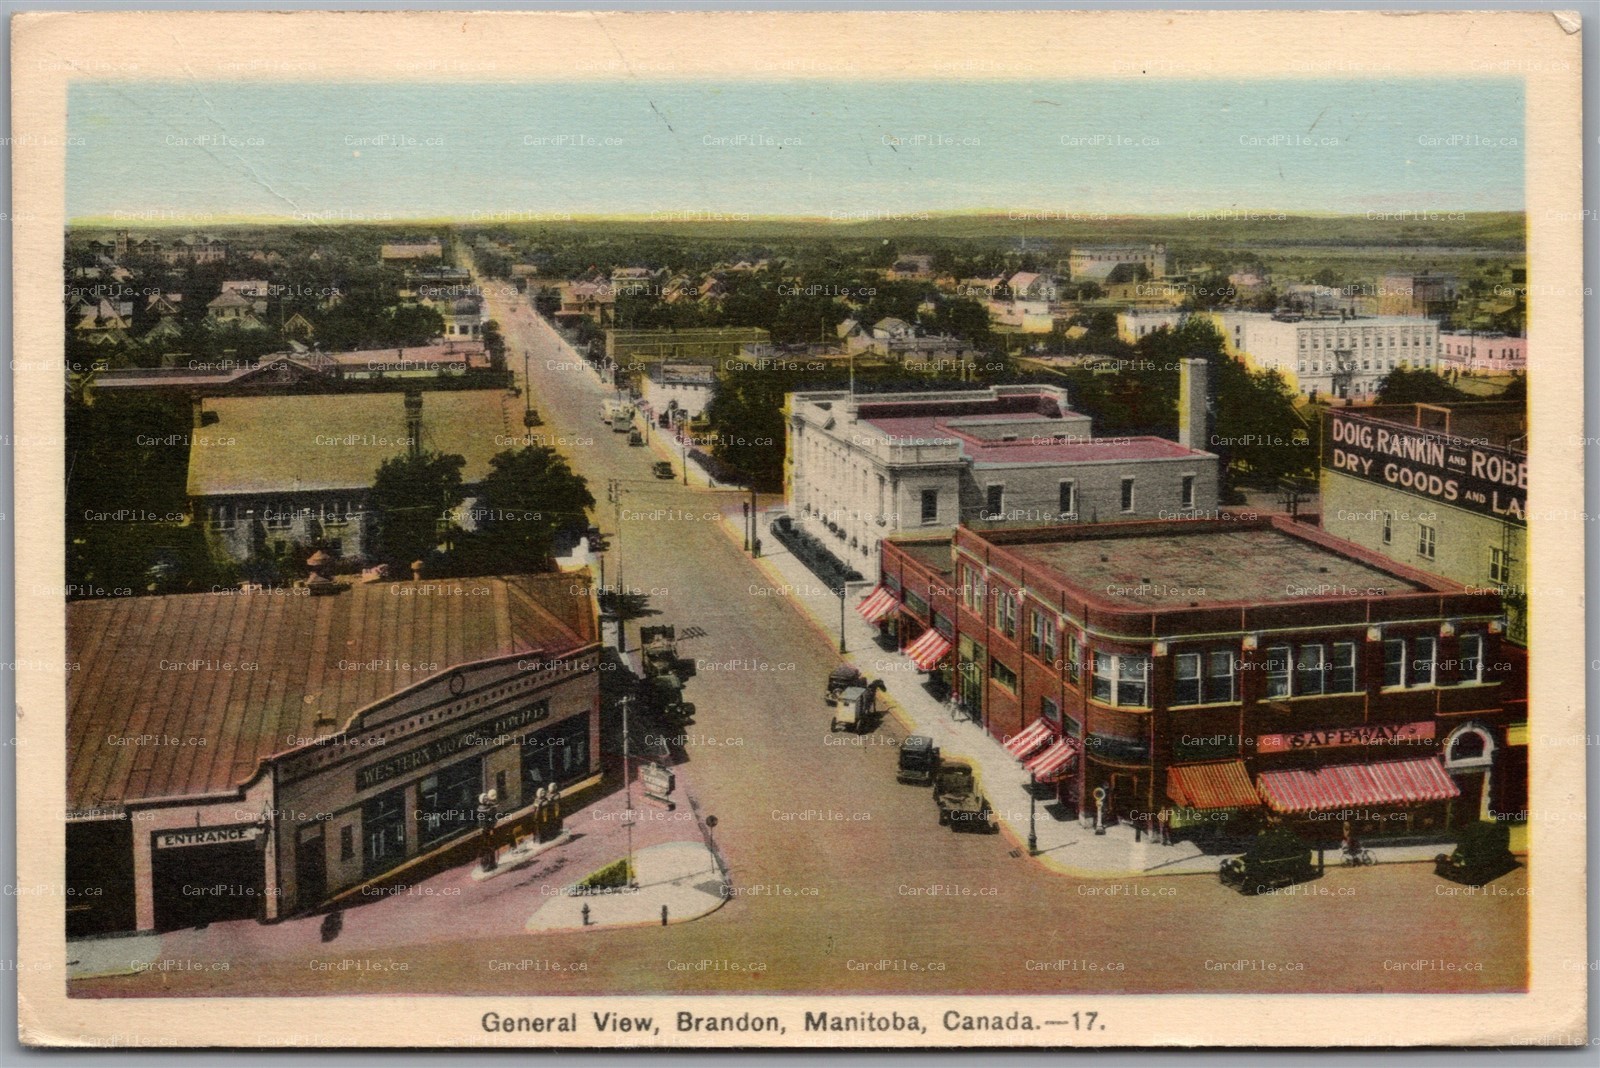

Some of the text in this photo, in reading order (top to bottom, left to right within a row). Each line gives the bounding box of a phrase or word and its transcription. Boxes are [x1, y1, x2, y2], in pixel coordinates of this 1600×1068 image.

[1333, 419, 1374, 452] DOIG,
[1377, 429, 1445, 468] RANKIN
[1448, 454, 1467, 466] AND
[1334, 449, 1373, 475] DRY
[1384, 463, 1459, 501] GOODS
[1465, 490, 1486, 504] AND
[1292, 724, 1404, 747] SAFEWAY
[364, 748, 430, 785] WESTERN
[165, 829, 248, 845] ENTRANCE
